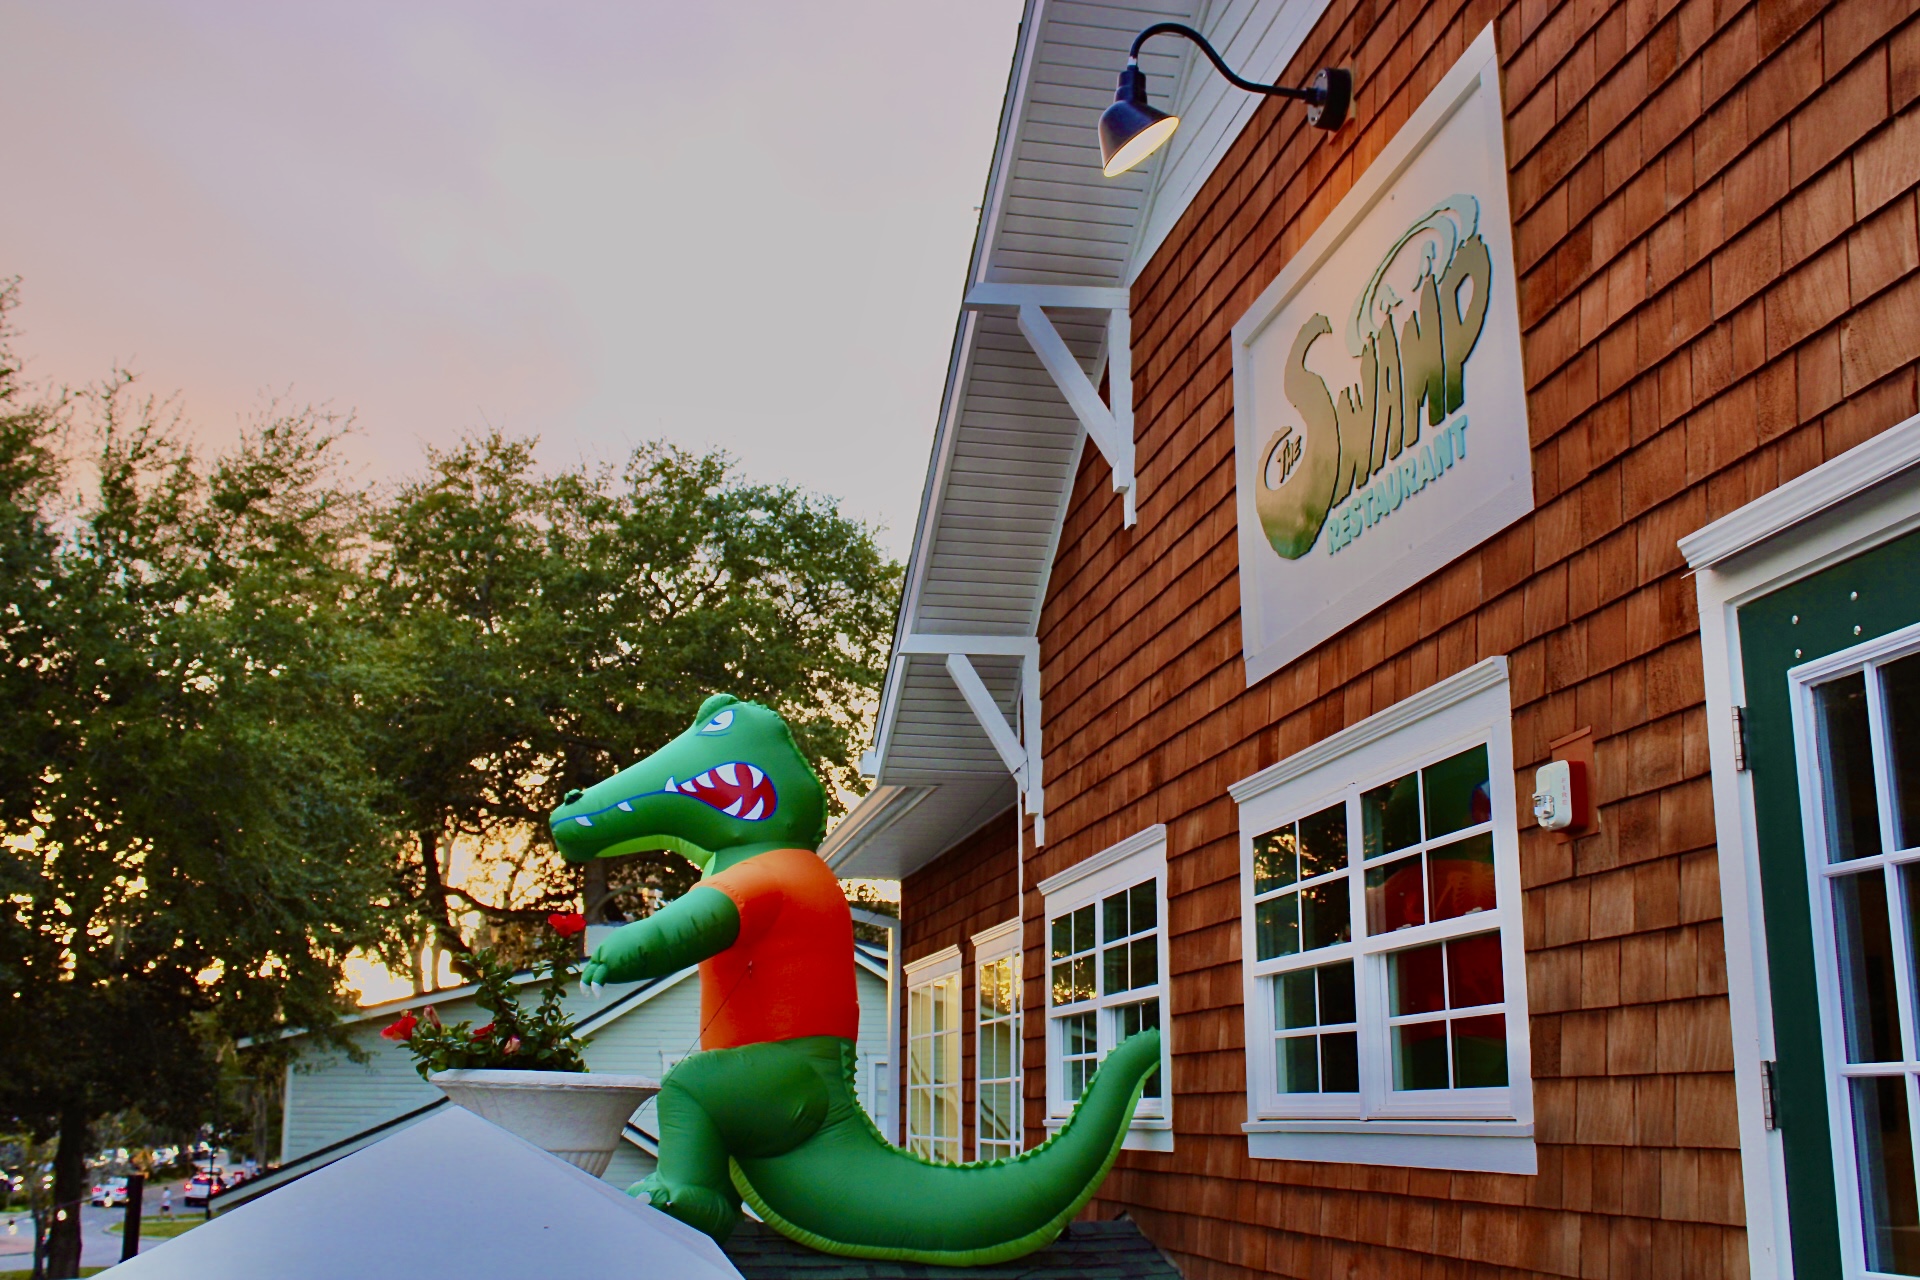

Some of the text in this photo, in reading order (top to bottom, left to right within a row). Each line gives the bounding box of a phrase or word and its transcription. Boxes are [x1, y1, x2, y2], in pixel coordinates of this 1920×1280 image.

[1256, 234, 1492, 560] SWAMP
[1276, 435, 1302, 483] THE
[1327, 414, 1468, 556] RESTAURANT
